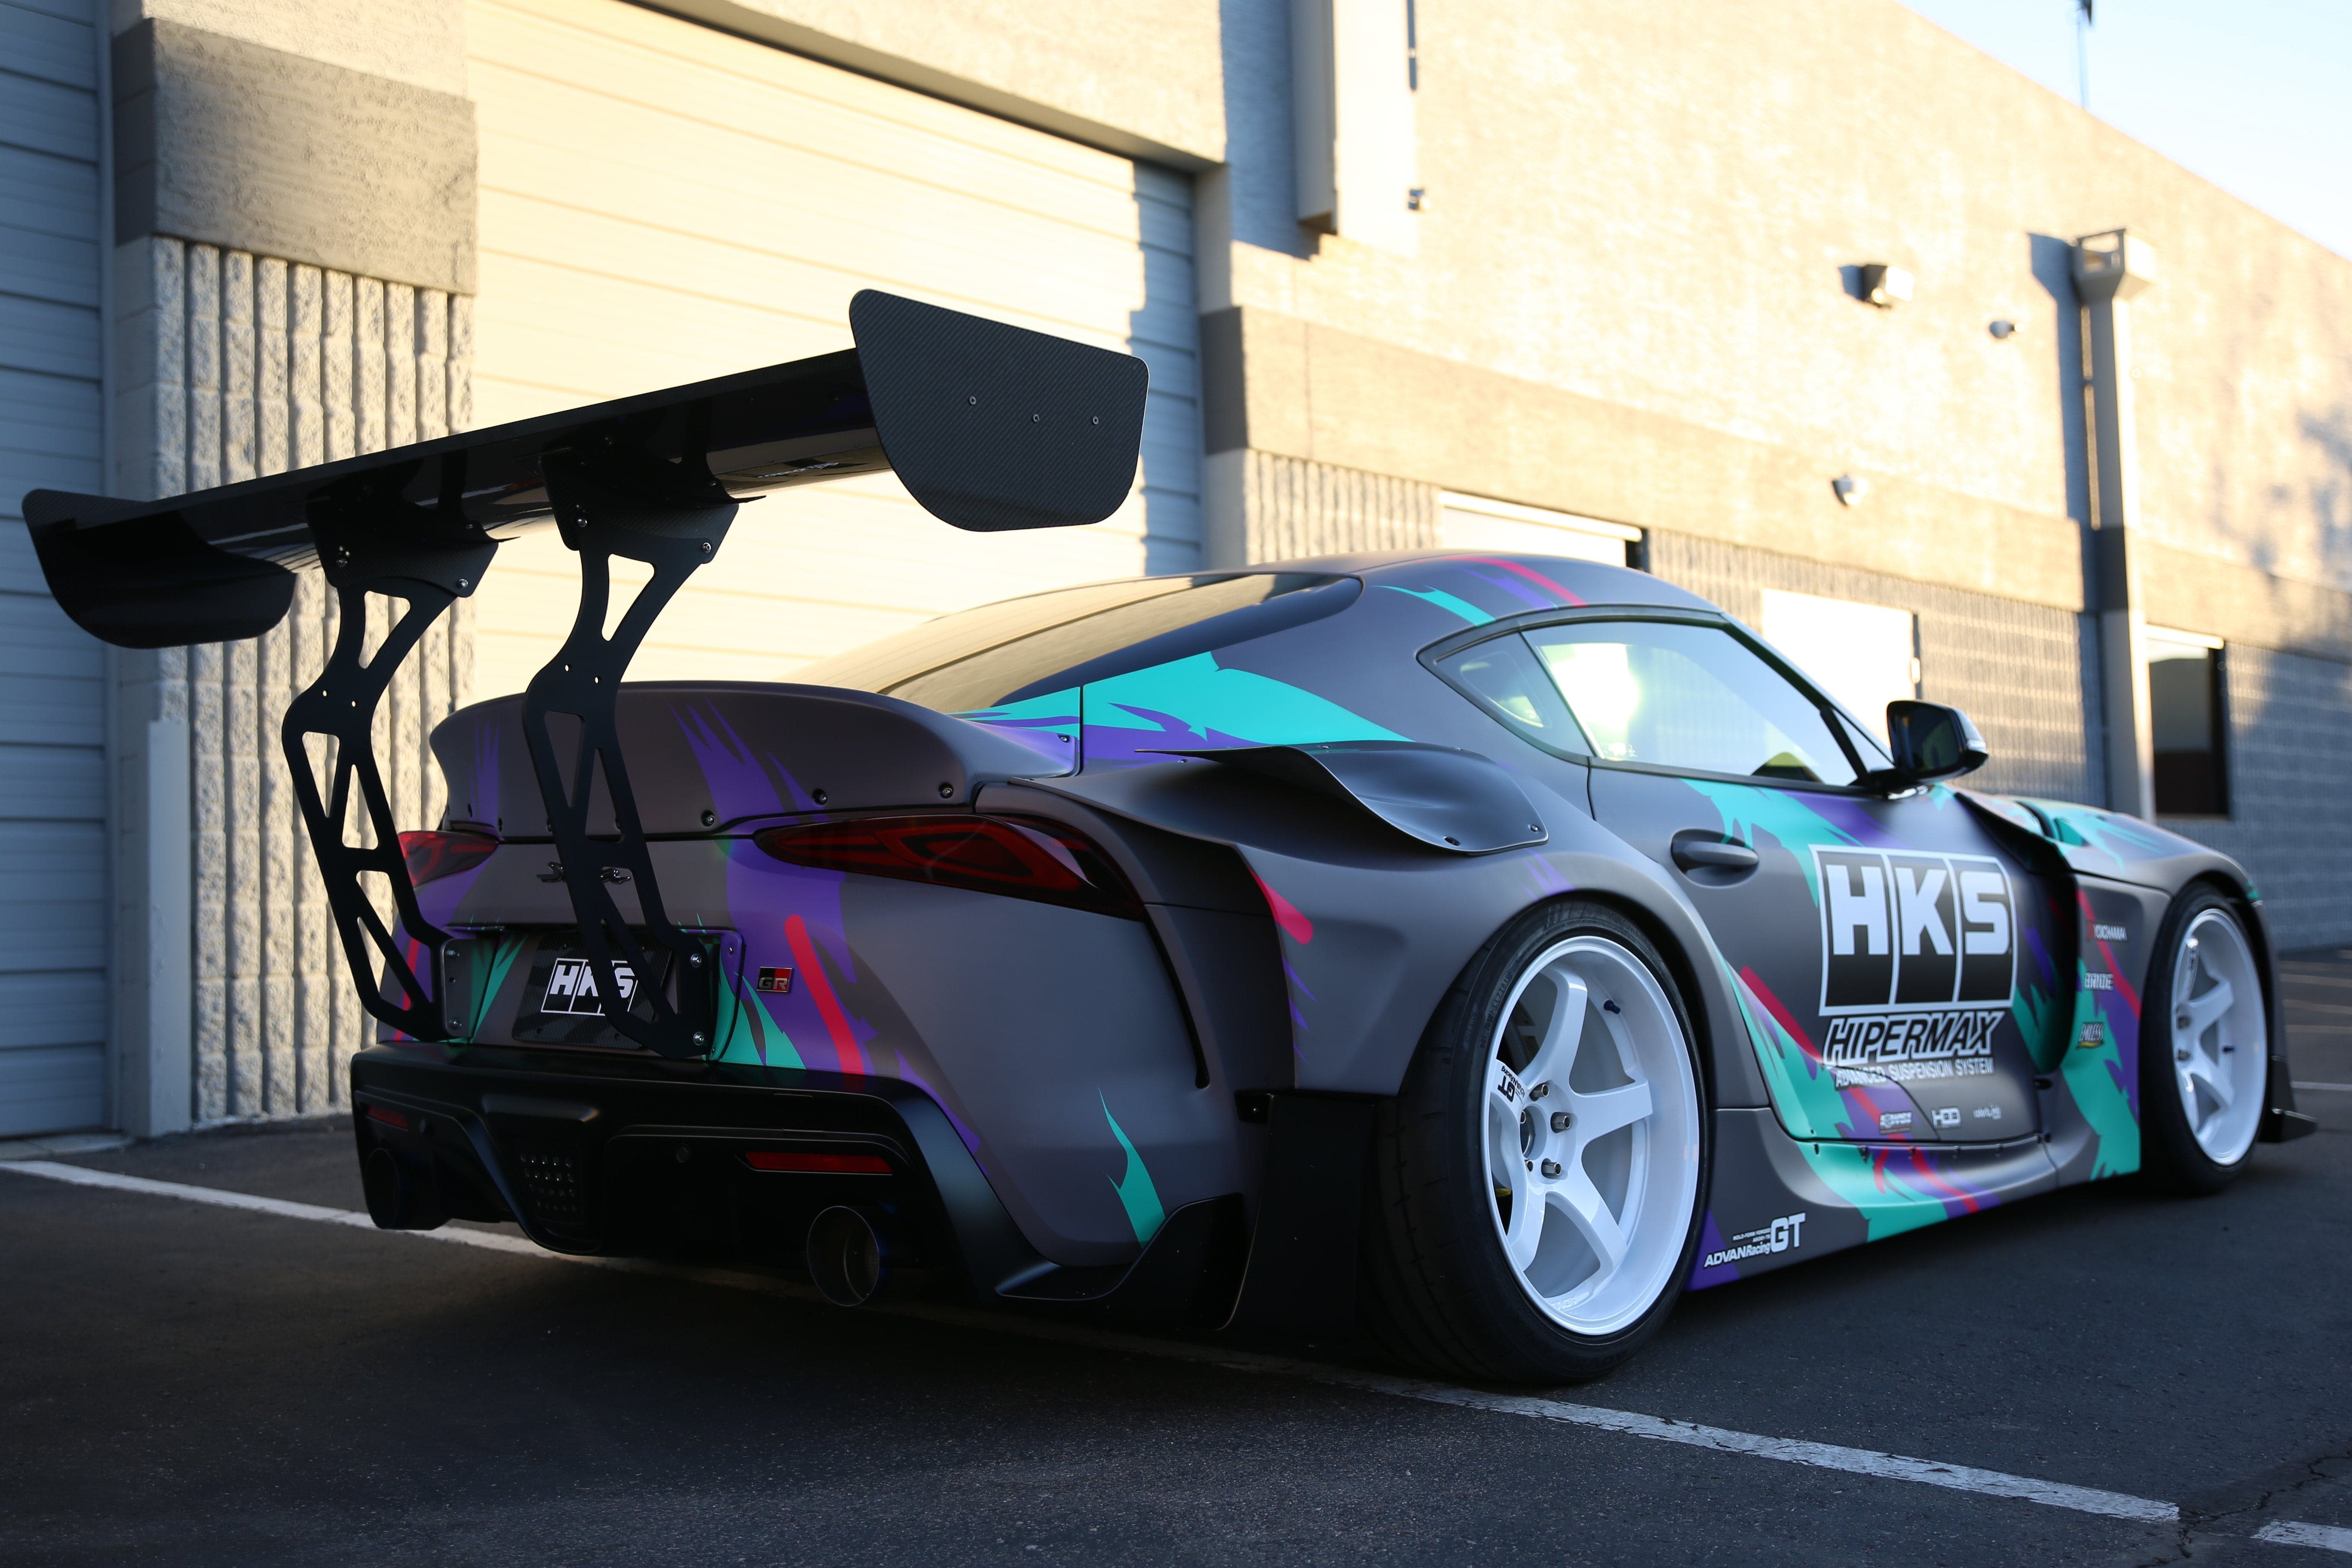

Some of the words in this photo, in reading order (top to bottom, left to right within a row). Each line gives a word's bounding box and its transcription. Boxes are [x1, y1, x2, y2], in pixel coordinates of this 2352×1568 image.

[1825, 864, 2010, 956] HKS
[758, 977, 788, 990] GR
[1824, 1011, 2006, 1066] HIPERMAX
[1498, 1075, 1516, 1102] GT
[1835, 1066, 1887, 1087] ADVANCED
[1888, 1059, 1954, 1081] SUSPENSION
[1955, 1057, 1995, 1076] SYSTEM
[1770, 1213, 1806, 1253] GT
